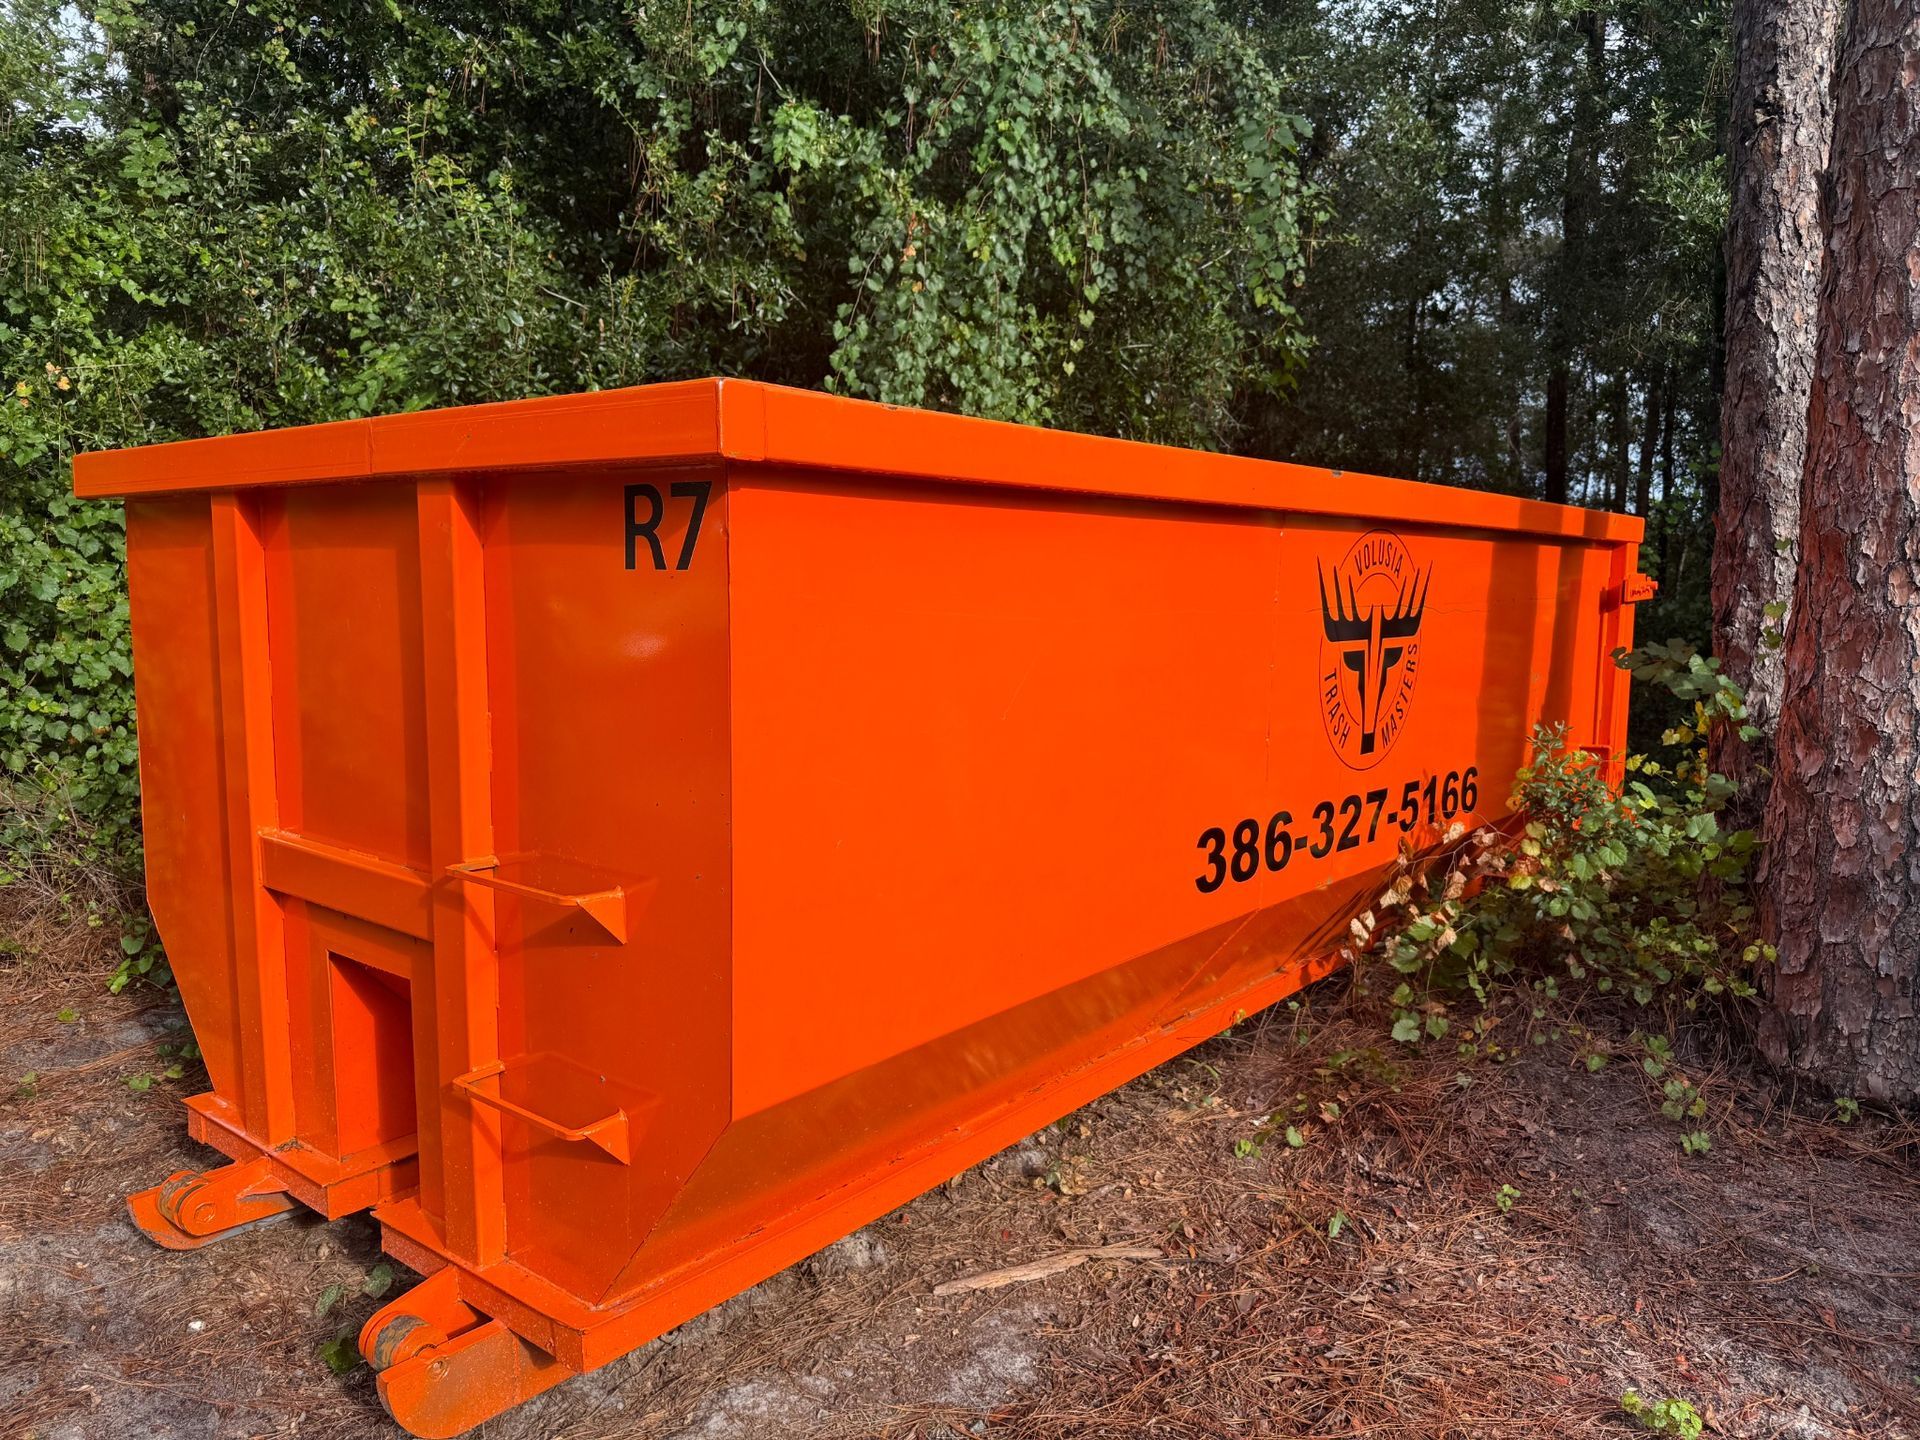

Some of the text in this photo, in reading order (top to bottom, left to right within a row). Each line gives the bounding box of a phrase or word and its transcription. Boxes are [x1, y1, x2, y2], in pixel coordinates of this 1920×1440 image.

[624, 481, 712, 570] R7
[1354, 539, 1403, 579] VOLUSIA
[1324, 643, 1417, 749] TRASH MASTERS
[1195, 766, 1478, 893] 386-327-5166
